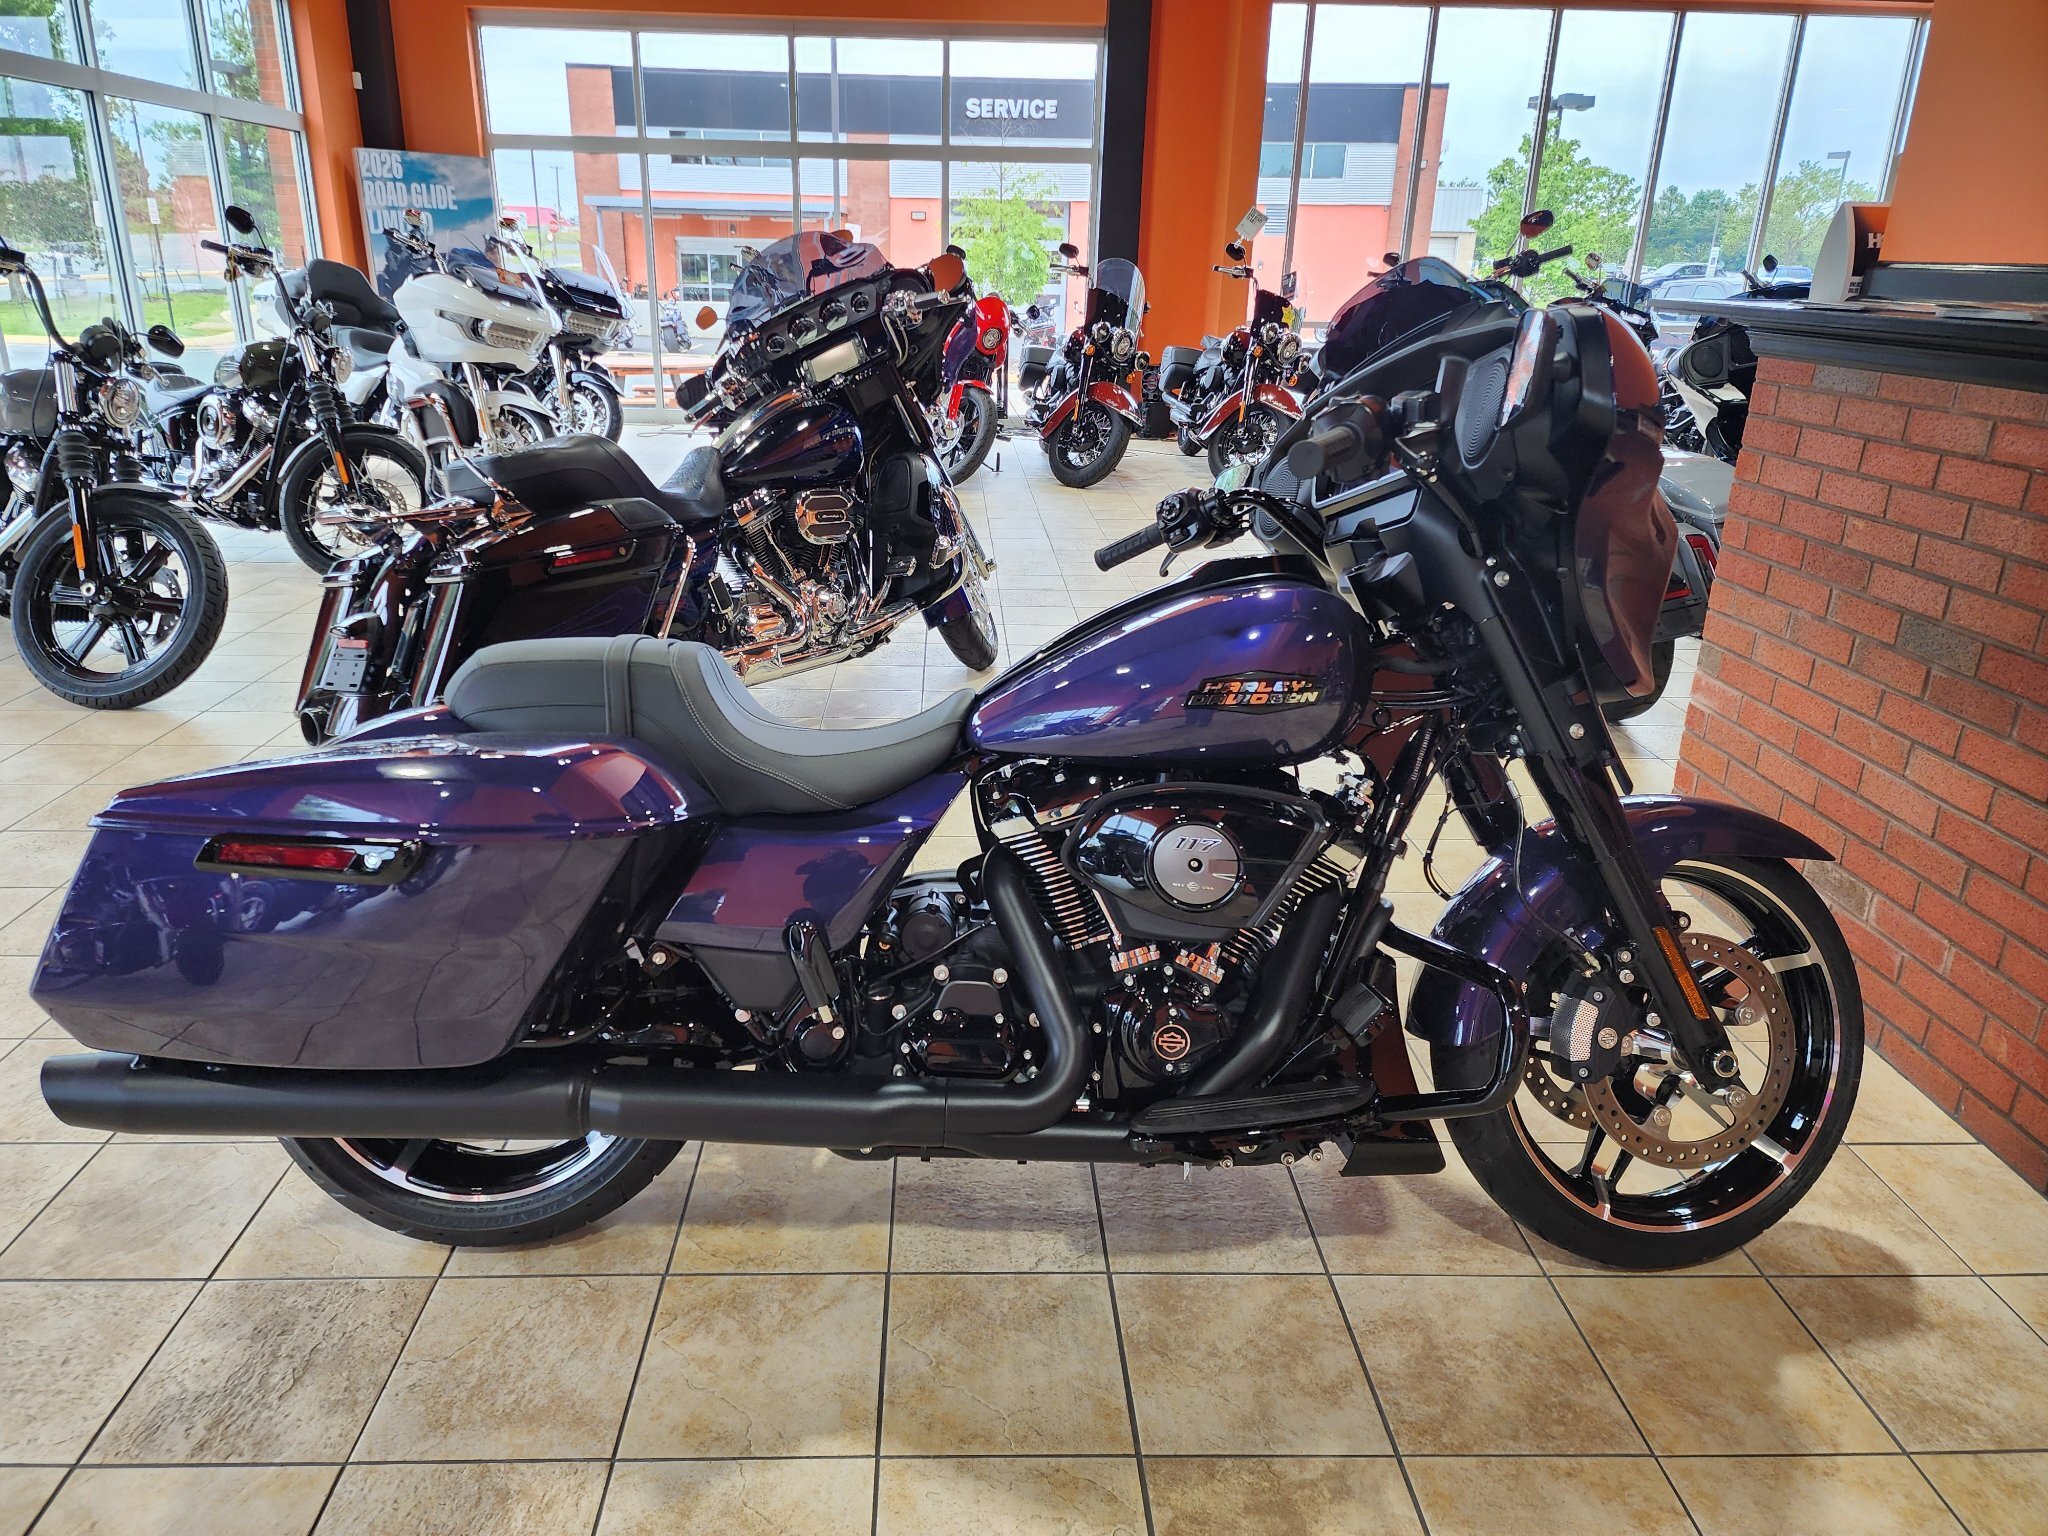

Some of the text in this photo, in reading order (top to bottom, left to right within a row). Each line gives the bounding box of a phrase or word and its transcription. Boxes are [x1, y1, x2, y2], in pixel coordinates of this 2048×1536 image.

[965, 97, 1058, 120] SERVICE
[358, 151, 403, 179] 2026
[363, 180, 458, 210] ROAD GLIDE
[1173, 836, 1223, 853] 117
